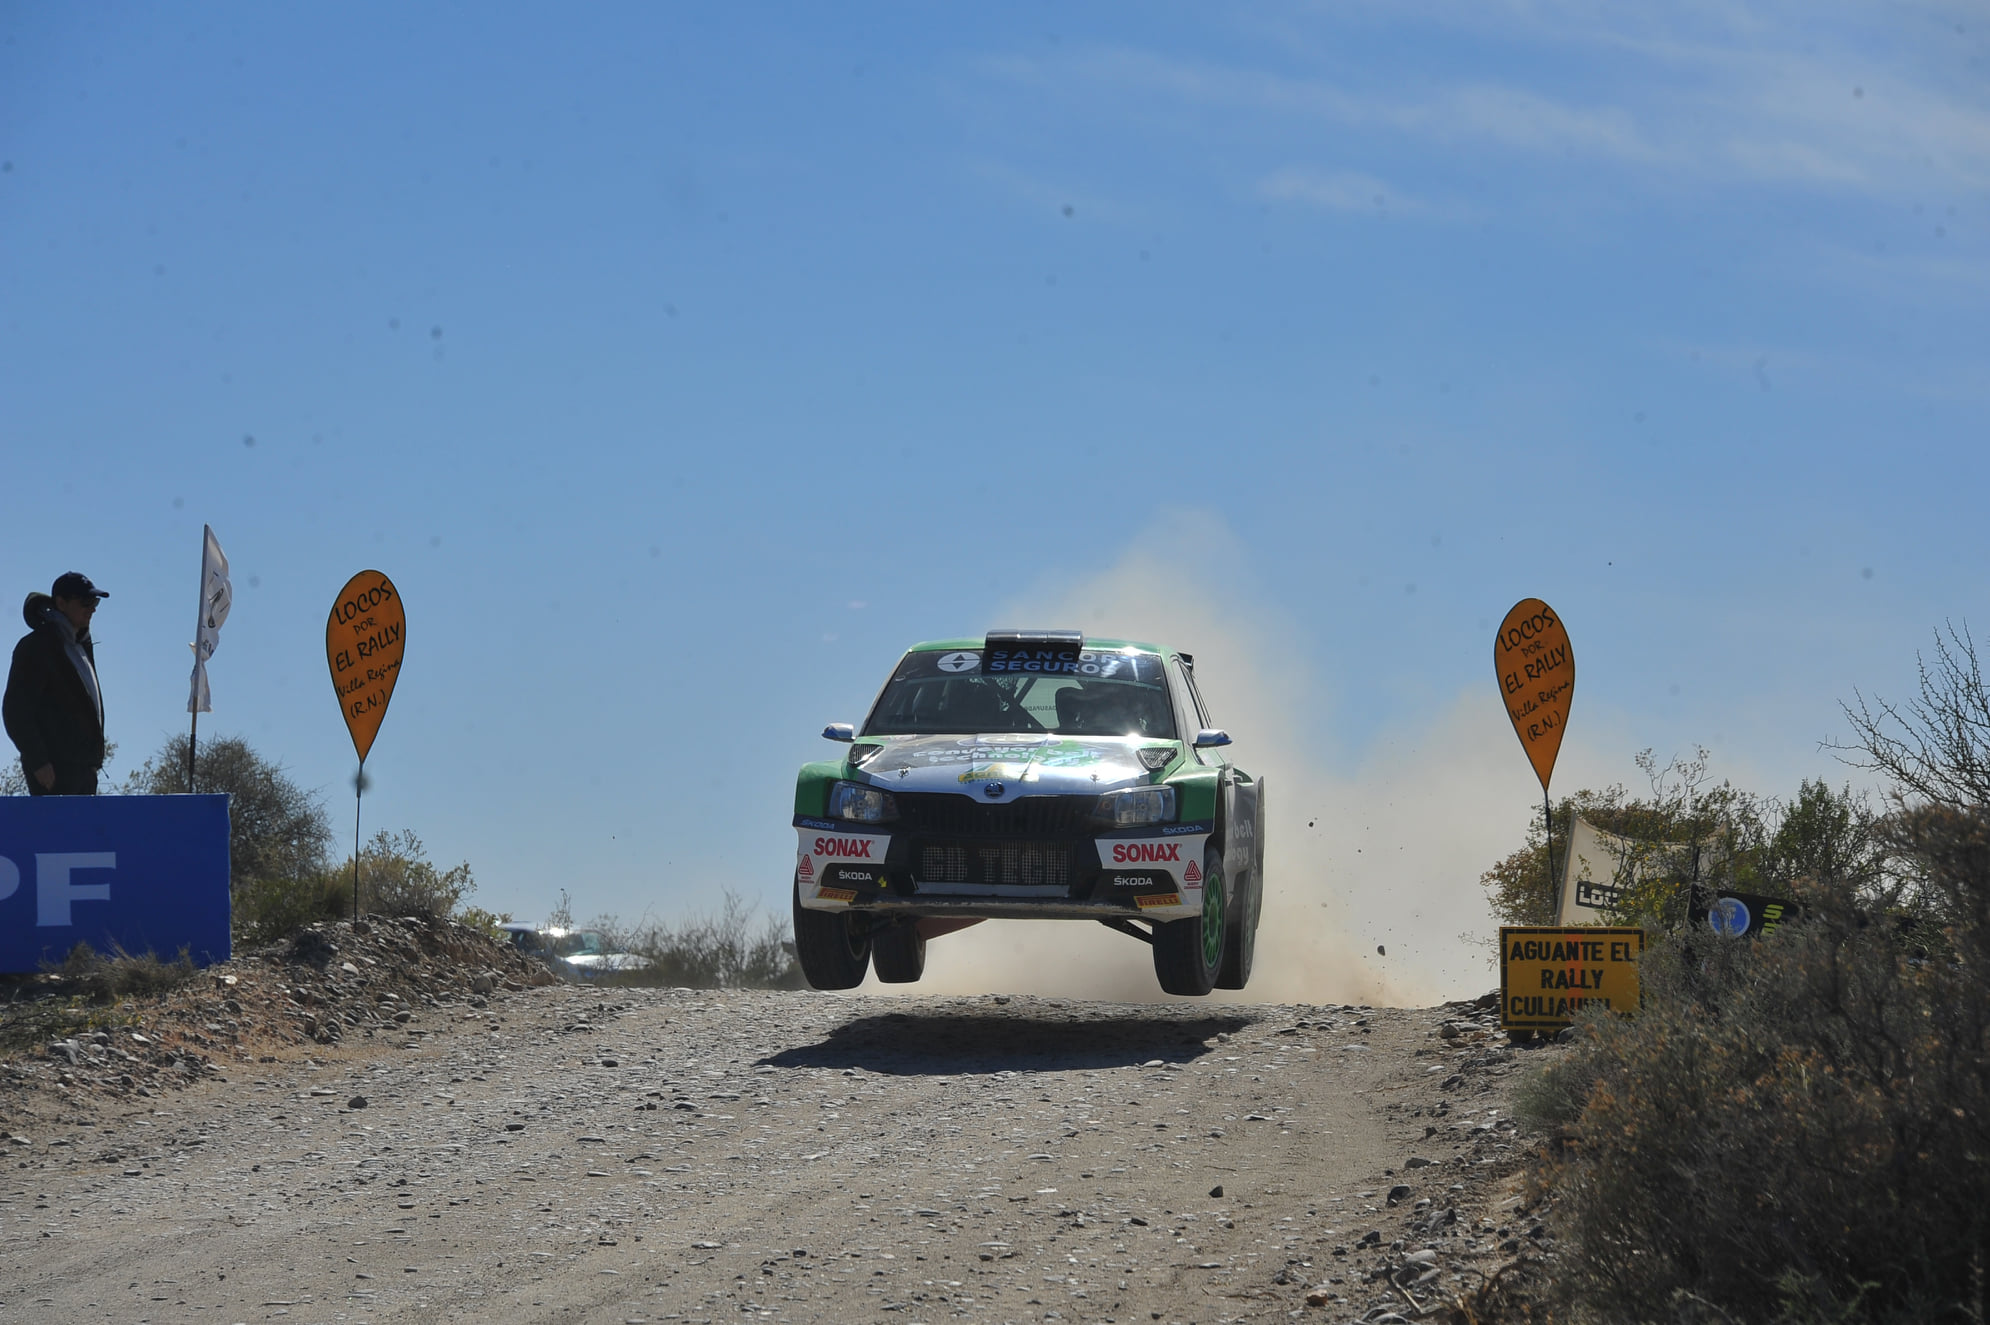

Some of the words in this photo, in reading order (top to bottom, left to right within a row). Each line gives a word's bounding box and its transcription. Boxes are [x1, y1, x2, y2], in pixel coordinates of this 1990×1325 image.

[335, 579, 393, 626] LOCOS
[353, 617, 377, 635] POR
[1500, 607, 1555, 653] LOCOS
[335, 649, 355, 673] EL
[356, 621, 400, 660] RALLY
[1521, 640, 1545, 658] POR
[338, 677, 366, 698] Villa
[366, 658, 400, 682] Regina
[1505, 671, 1524, 694] EL
[1524, 643, 1567, 682] RALLY
[350, 688, 386, 720] (R.N.)
[1511, 700, 1539, 722] Villa
[1538, 680, 1570, 704] Regina
[1527, 710, 1561, 742] (R.N.)
[1162, 825, 1204, 834] ŠKODA
[813, 837, 872, 858] SONAX
[1112, 843, 1180, 863] SONAX
[838, 869, 873, 881] ŠKODA
[978, 847, 1069, 885] TECH
[1113, 876, 1153, 886] ŠKODA
[1510, 940, 1604, 962] AGUANTE
[1610, 942, 1637, 962] EL
[1541, 968, 1604, 989] RALLY
